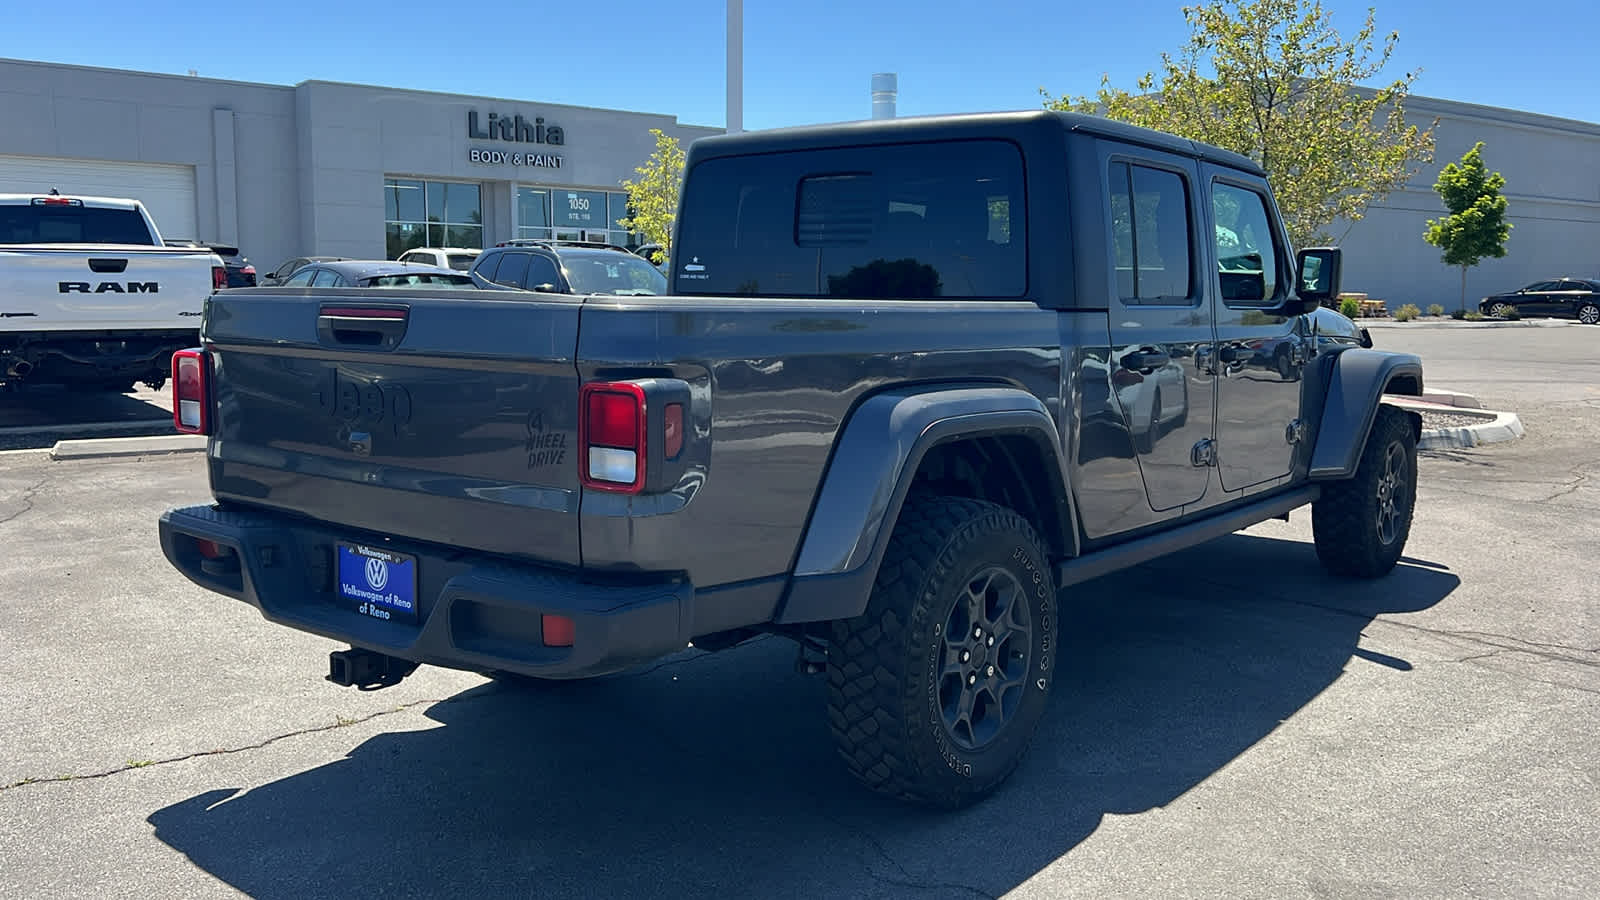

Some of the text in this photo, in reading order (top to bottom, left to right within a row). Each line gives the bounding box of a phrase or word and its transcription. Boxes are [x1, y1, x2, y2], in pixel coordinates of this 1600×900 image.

[468, 110, 565, 146] Lithia
[470, 150, 566, 169] BODY & PAINT
[568, 198, 590, 211] 1050
[58, 281, 159, 294] RAM
[318, 366, 413, 439] Jeep
[526, 433, 568, 451] WHEEL
[527, 450, 566, 470] DRIVE
[357, 545, 392, 561] Volkswagen
[342, 583, 412, 609] Volkswagen of Reno
[359, 602, 391, 619] of Reno
